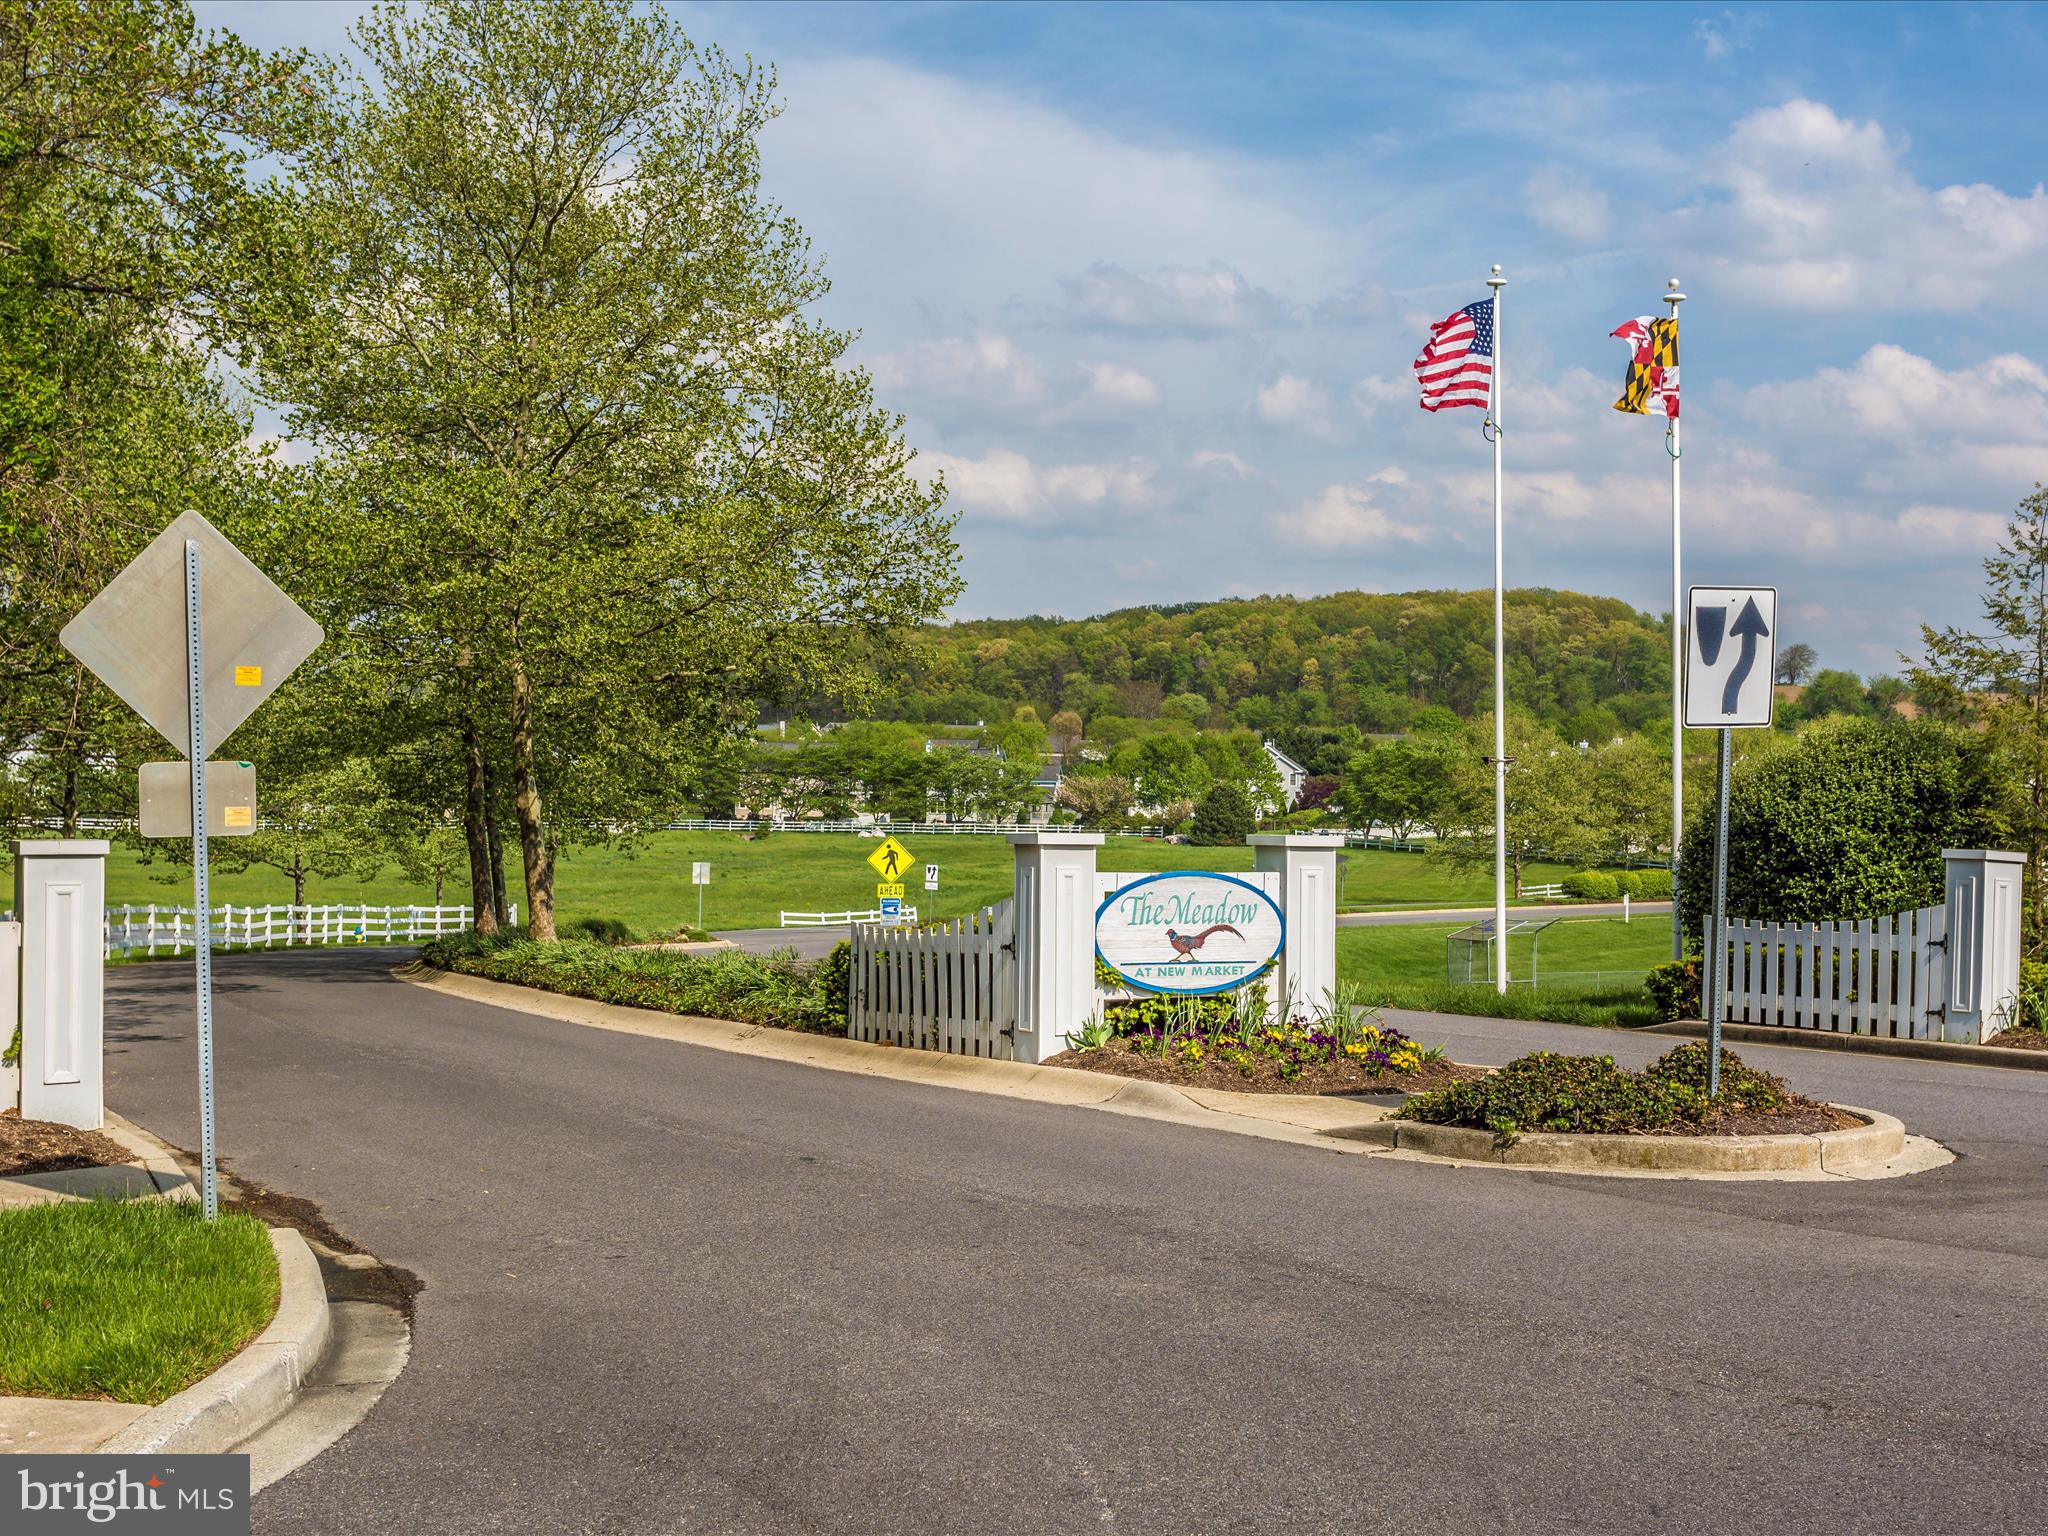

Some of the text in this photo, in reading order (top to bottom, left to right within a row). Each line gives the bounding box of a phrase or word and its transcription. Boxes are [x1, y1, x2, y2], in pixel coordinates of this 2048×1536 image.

[879, 886, 903, 896] AHEAD
[1121, 891, 1258, 925] The Meadow
[1135, 966, 1245, 977] AT NEW MARKET
